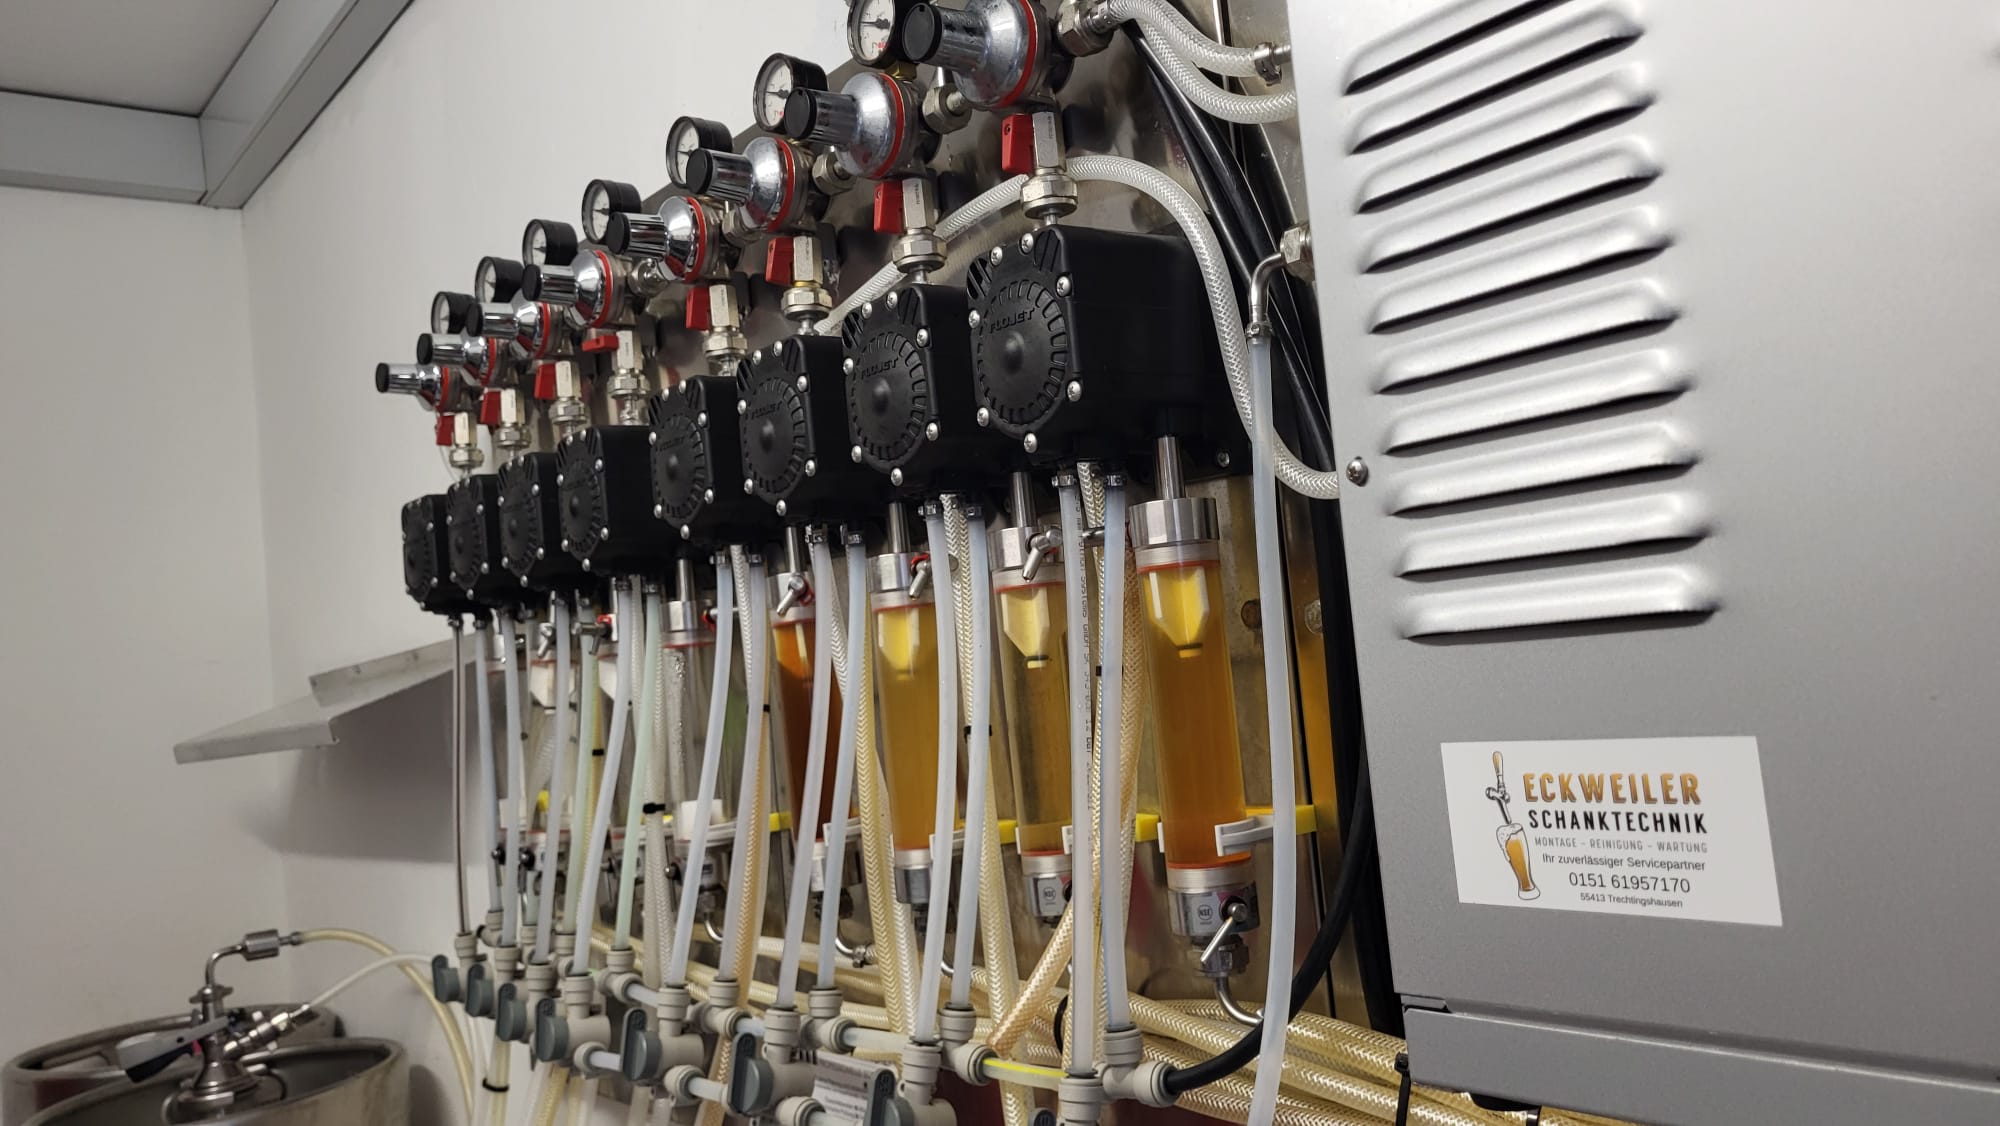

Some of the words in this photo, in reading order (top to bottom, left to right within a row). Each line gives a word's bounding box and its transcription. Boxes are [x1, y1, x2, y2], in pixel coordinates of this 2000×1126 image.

[990, 307, 1035, 334] FLOJET
[1522, 772, 1702, 805] ECKWEILER
[1528, 810, 1707, 834] SCHANKTECHNIK
[1534, 837, 1577, 848] MONTAGE
[1589, 839, 1643, 851] REINIGUNG
[1657, 841, 1708, 853] WARTUNG
[1542, 853, 1554, 863] Ihr
[1558, 854, 1623, 868] zuverlässiger
[1627, 856, 1705, 872] Servicepartner
[1568, 872, 1606, 888] 0151
[1611, 874, 1691, 893] 61957170
[1580, 892, 1606, 902] 55413
[1608, 894, 1683, 908] Trechtingshausen
